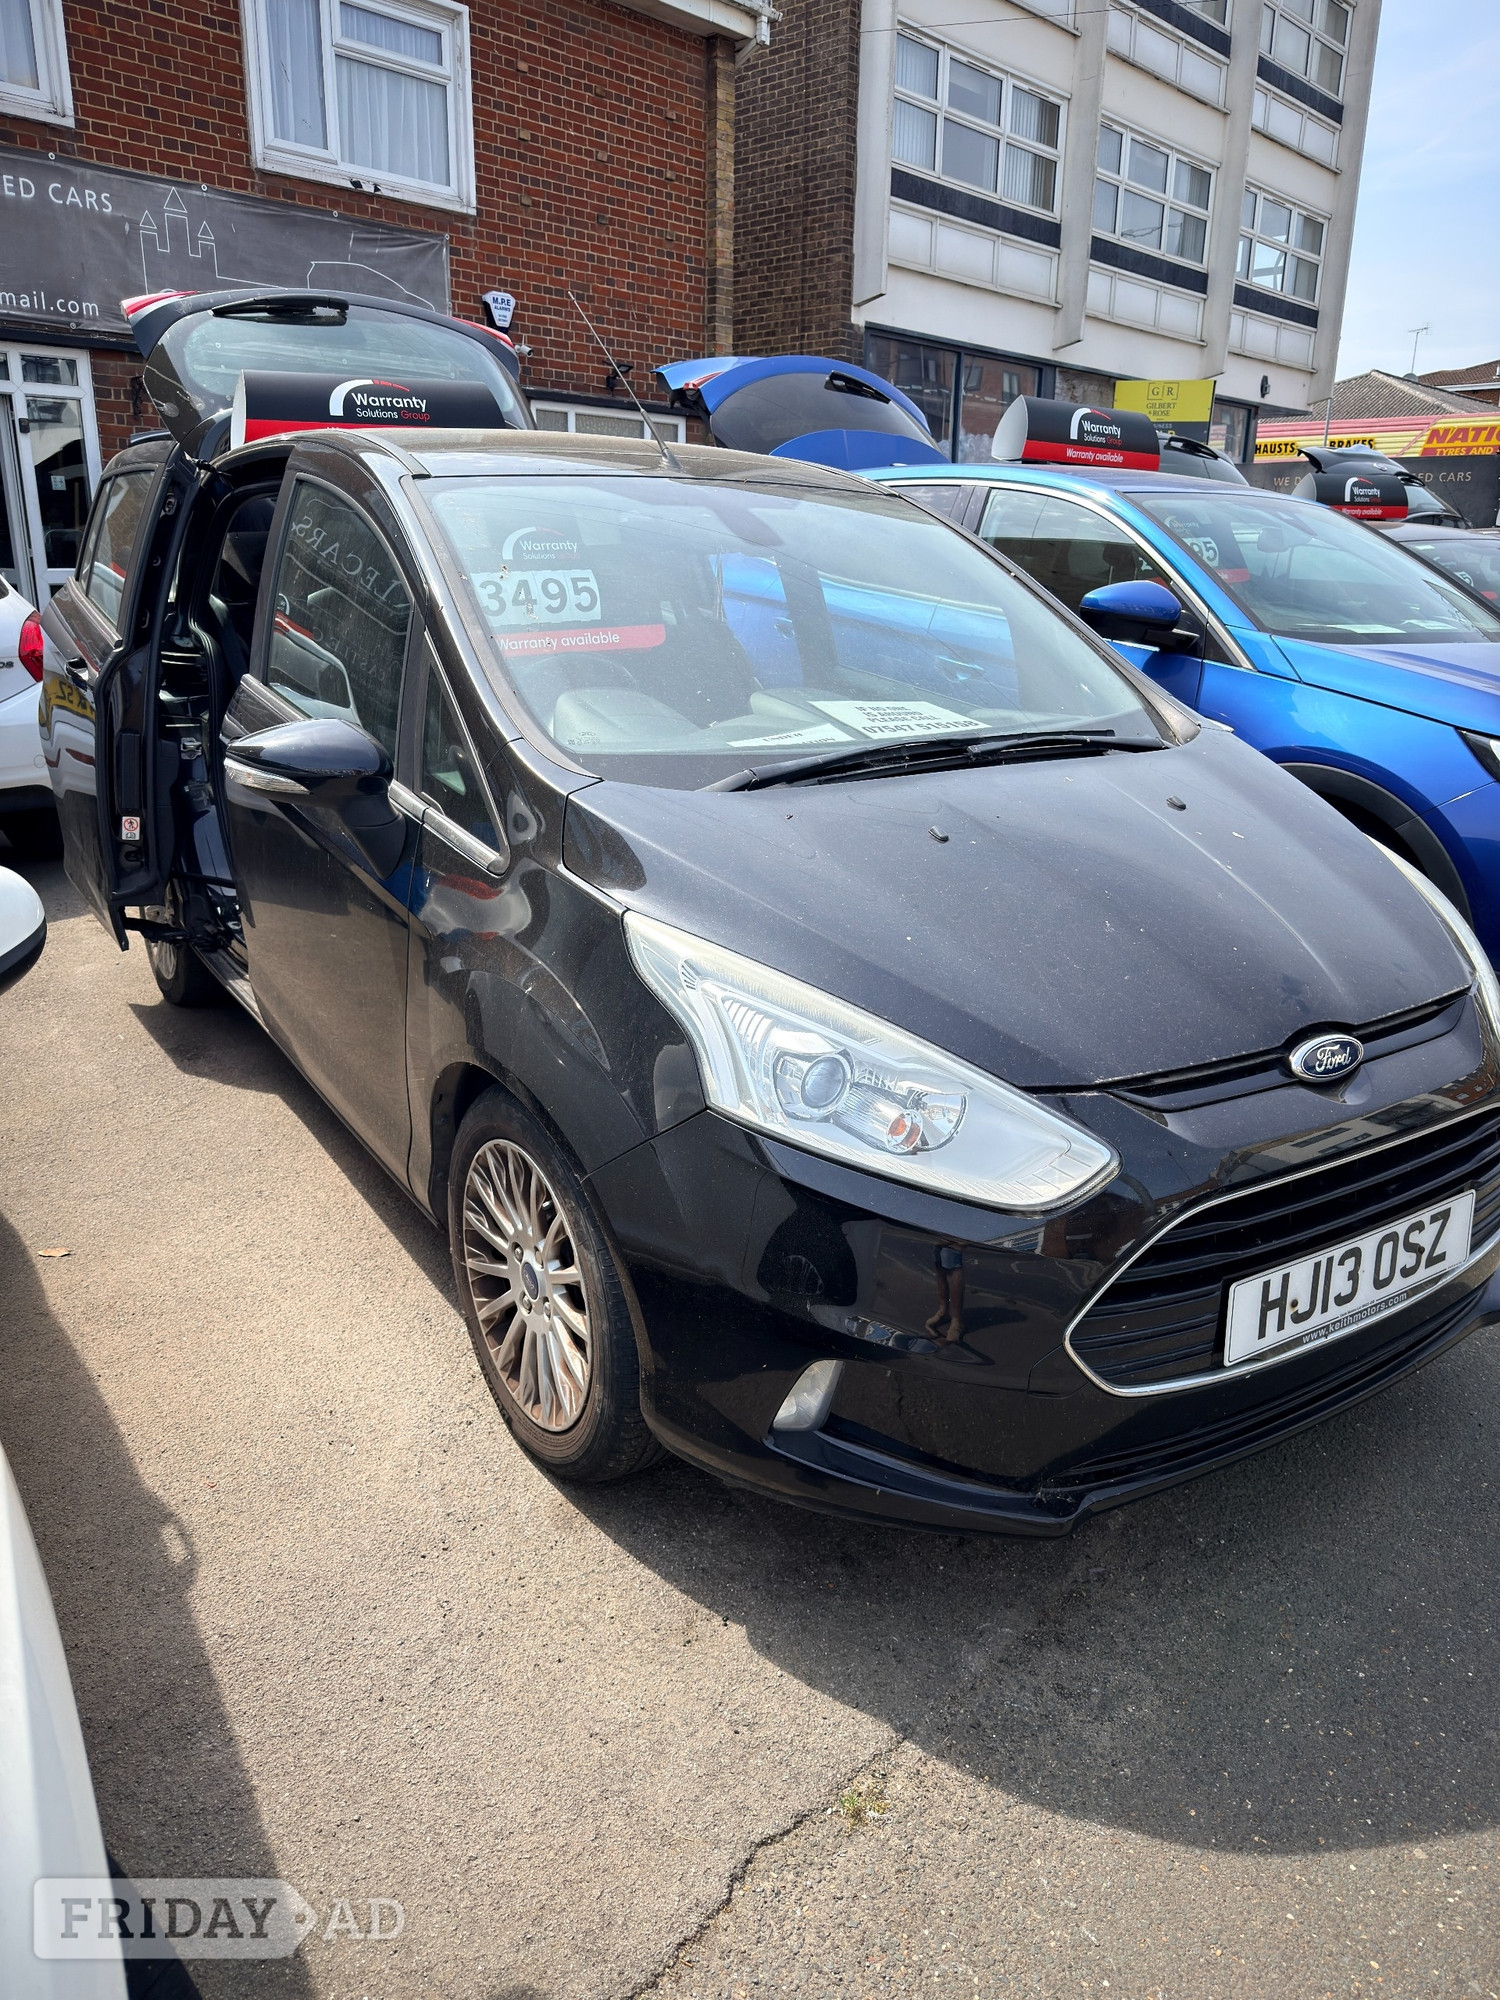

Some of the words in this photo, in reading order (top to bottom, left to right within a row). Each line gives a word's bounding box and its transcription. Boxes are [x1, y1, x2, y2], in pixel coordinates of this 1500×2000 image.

[48, 183, 113, 213] CARS
[351, 392, 427, 412] Warranty
[1146, 402, 1177, 410] GILBERT
[356, 407, 399, 419] Solutions
[400, 410, 431, 422] Group
[1081, 420, 1121, 438] Warranty
[1426, 426, 1500, 445] NATI
[1084, 433, 1106, 444] Solutions
[1107, 436, 1123, 447] Group
[1066, 448, 1095, 462] Warranty
[1096, 450, 1124, 463] available
[1436, 447, 1467, 456] TYRES
[1469, 446, 1494, 455] AND
[1438, 471, 1472, 482] CARS
[1352, 486, 1381, 498] Warranty
[519, 540, 578, 553] Warranty
[522, 552, 556, 560] Solutions
[479, 576, 598, 617] 3495
[497, 636, 558, 651] Warranty
[561, 632, 621, 646] available
[862, 724, 916, 734] 07547
[1315, 1044, 1352, 1072] Ford
[1258, 1247, 1363, 1341] HJ13
[1373, 1207, 1452, 1291] OSZ
[1302, 1291, 1408, 1344] www.keithmotors.com
